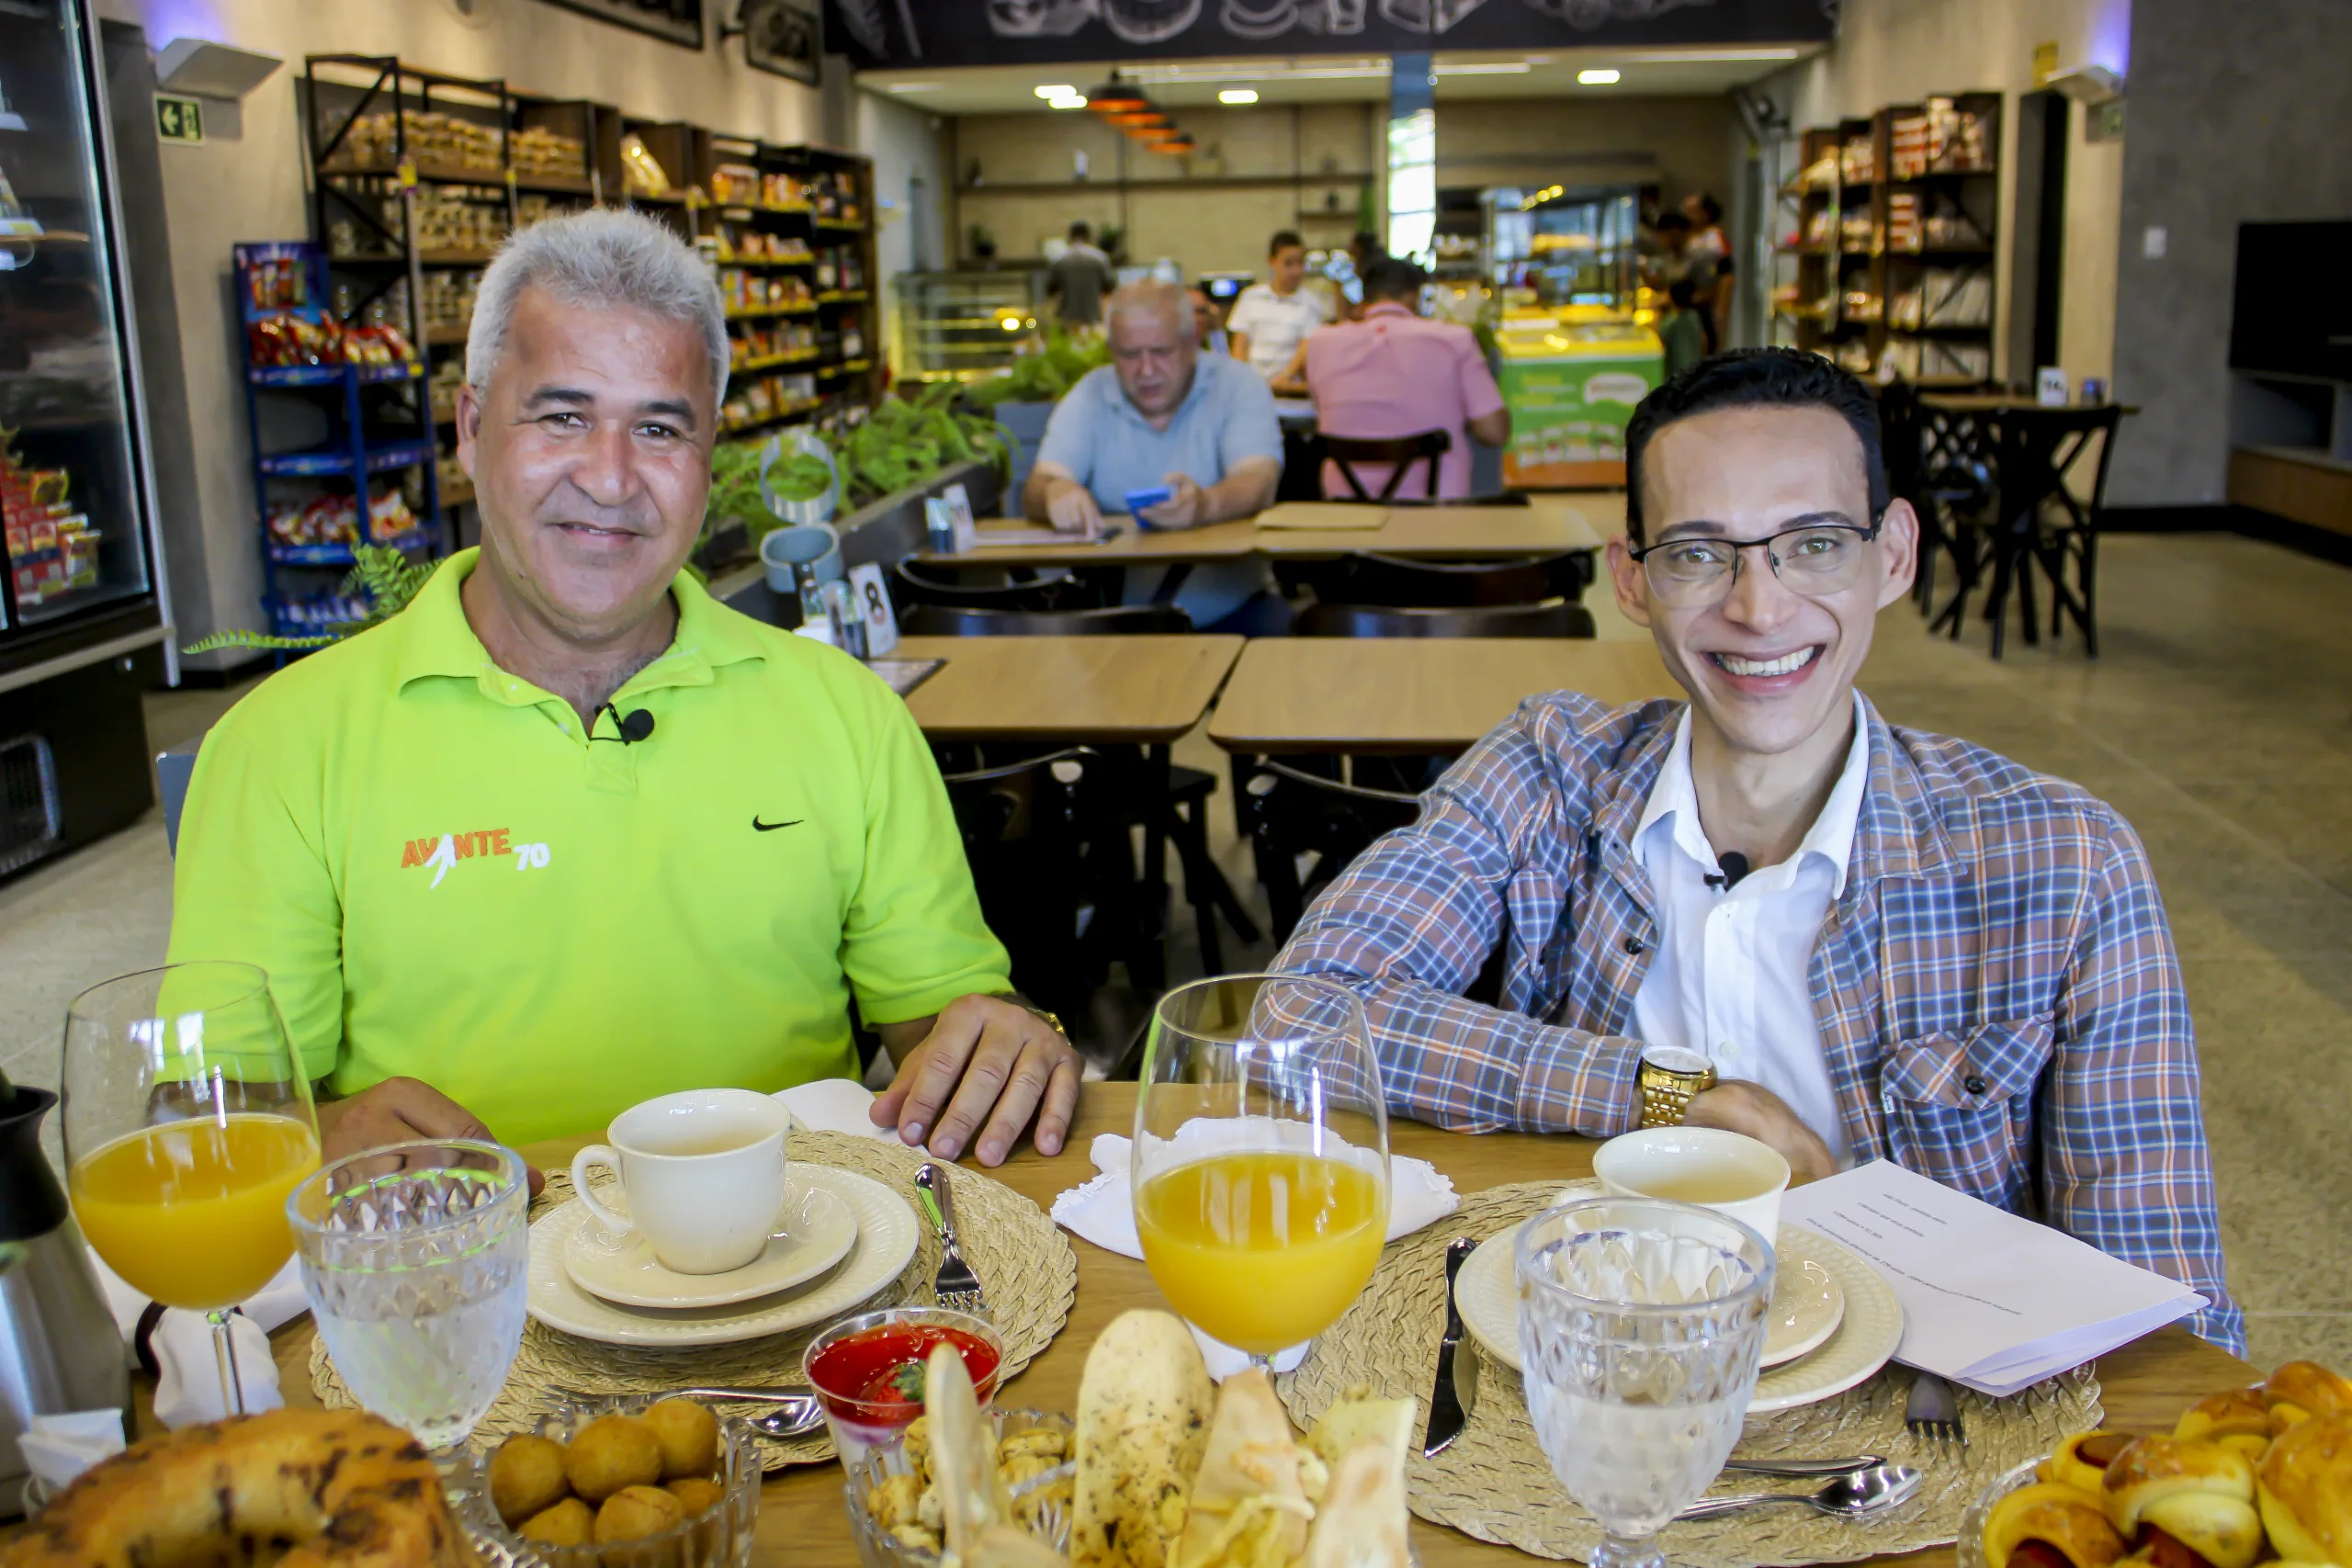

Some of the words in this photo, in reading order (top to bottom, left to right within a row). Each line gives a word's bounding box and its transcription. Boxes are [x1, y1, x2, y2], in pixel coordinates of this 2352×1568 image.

[865, 582, 886, 625] 8
[400, 828, 512, 889] AVANTE
[514, 841, 551, 872] 70
